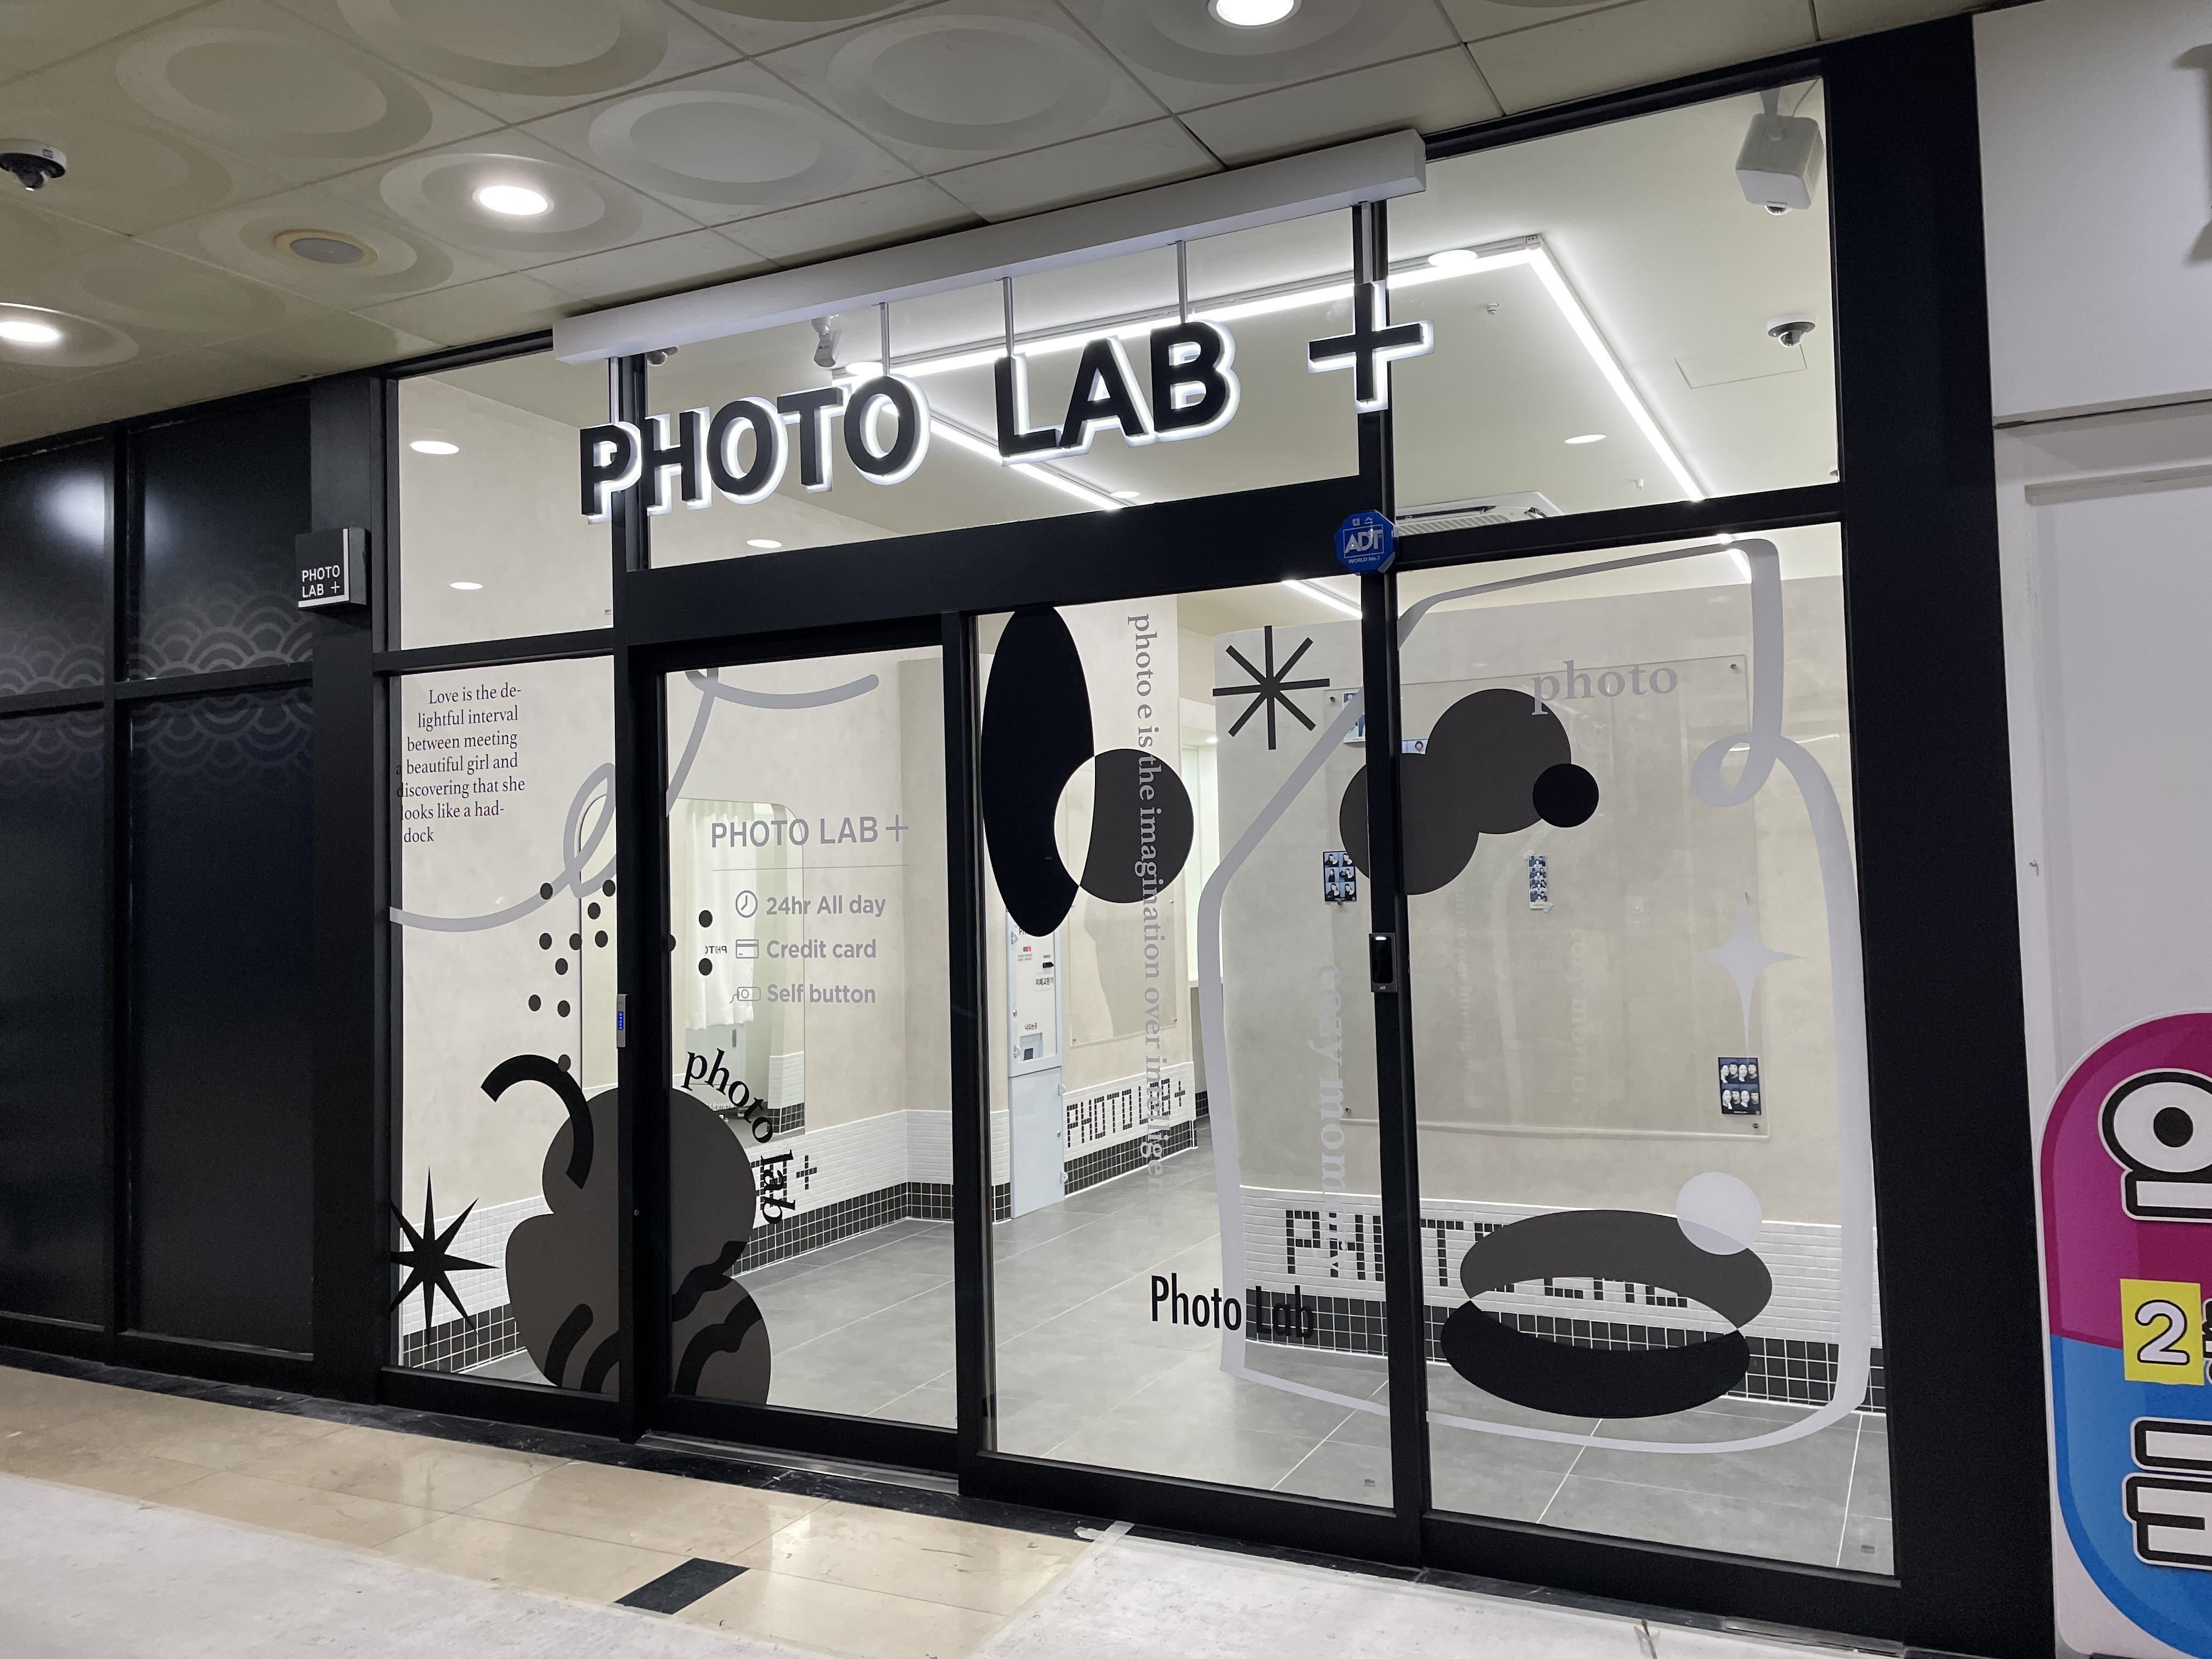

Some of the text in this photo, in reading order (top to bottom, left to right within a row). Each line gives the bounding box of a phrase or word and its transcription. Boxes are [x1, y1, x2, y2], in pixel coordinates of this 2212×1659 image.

[580, 374, 930, 523] PHOTO
[993, 318, 1240, 466] LAB
[1345, 529, 1383, 553] ADT
[302, 565, 340, 582] PHOTO
[302, 583, 324, 598] LAB
[1127, 613, 1158, 697] photo
[428, 682, 522, 704] Love is the de-
[1530, 659, 1679, 716] photo
[417, 704, 518, 732] lightful interval
[407, 730, 518, 752] between meeting
[1137, 725, 1159, 748] is
[407, 755, 464, 775] beautiful
[467, 753, 489, 775] girl
[493, 752, 518, 769] and
[396, 775, 526, 799] discovering that she
[1138, 754, 1163, 801] the
[401, 799, 505, 820] looks like a had-
[403, 826, 435, 843] dock
[712, 818, 809, 848] PHOTO
[820, 816, 879, 844] LAB
[1134, 807, 1166, 980] imagination
[766, 895, 887, 917] 24hr All day
[766, 939, 877, 959] Credit card
[766, 984, 876, 1004] Self button
[1144, 988, 1161, 1053] over
[1307, 964, 1343, 1066] cozy
[1066, 1088, 1133, 1148] PHOTO
[680, 1047, 774, 1144] photo
[760, 1149, 796, 1224] lab
[1151, 1272, 1314, 1339] Photo Lab
